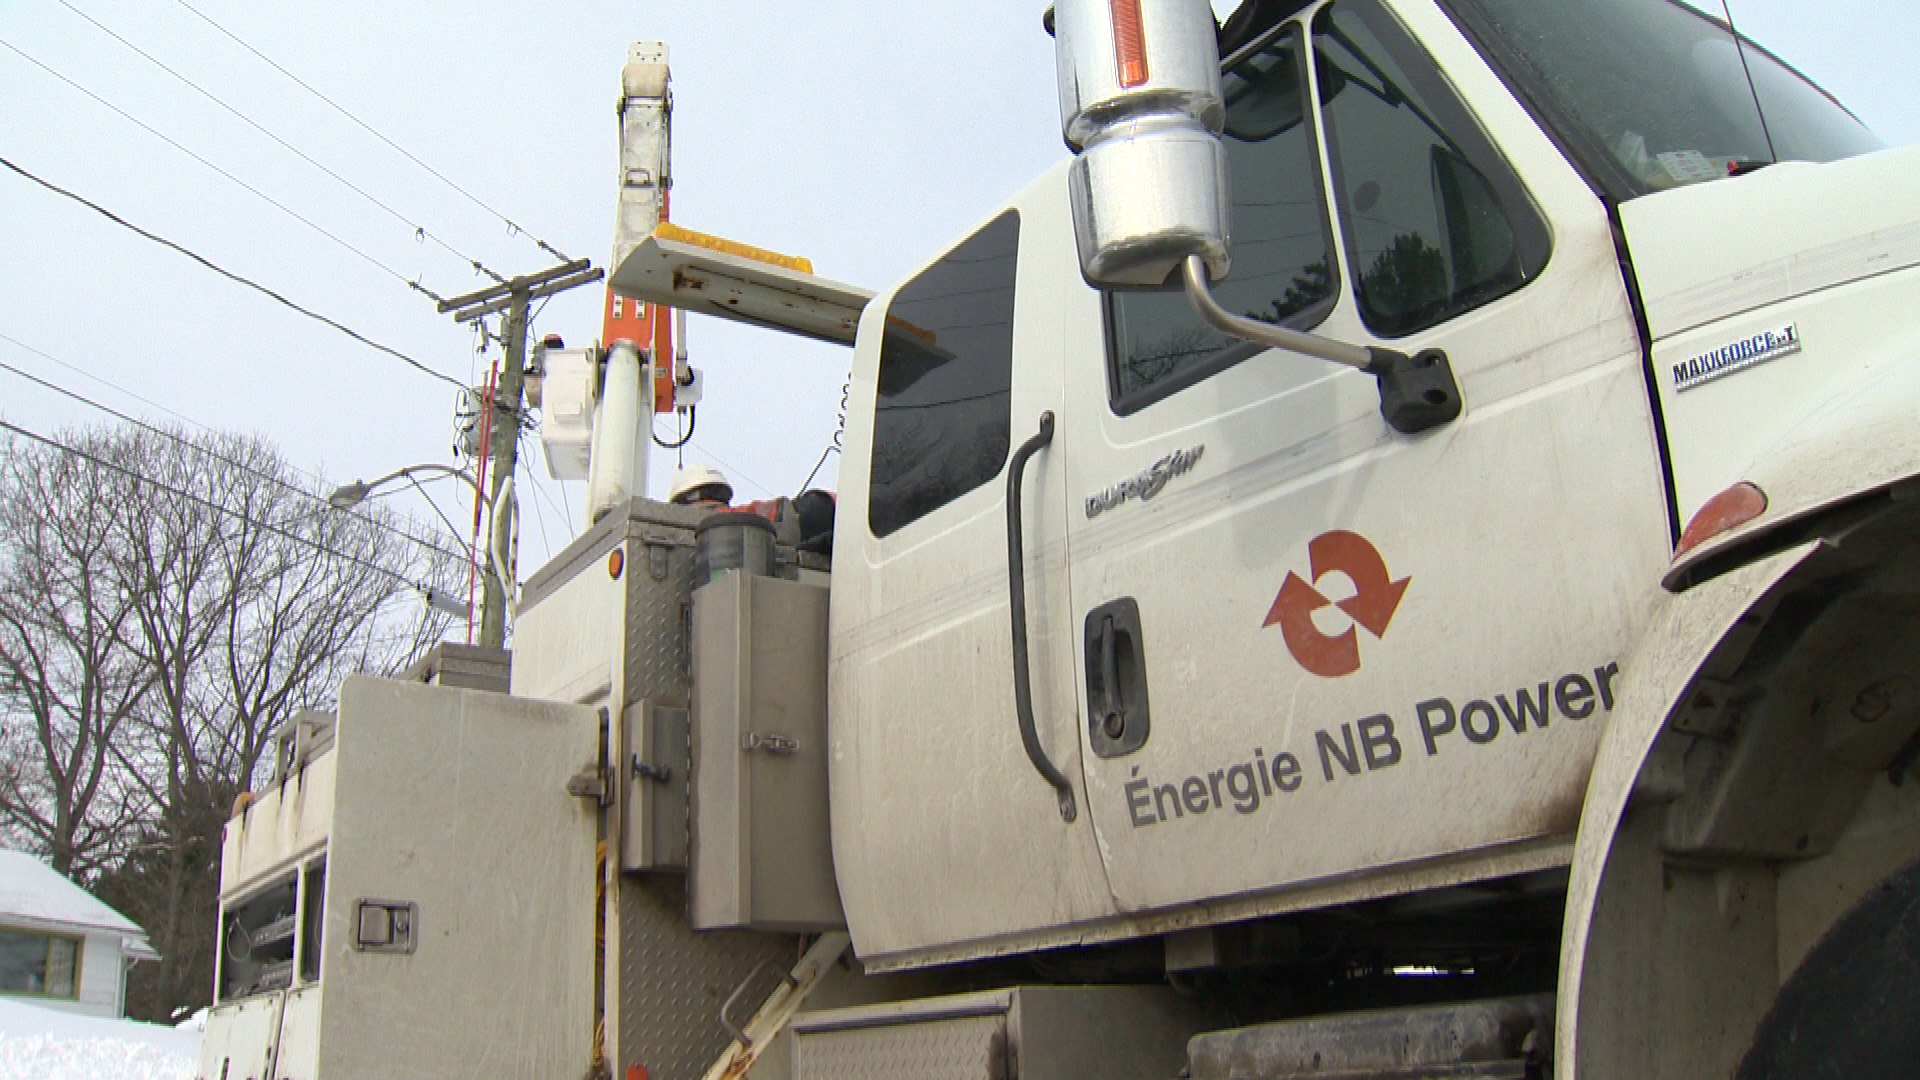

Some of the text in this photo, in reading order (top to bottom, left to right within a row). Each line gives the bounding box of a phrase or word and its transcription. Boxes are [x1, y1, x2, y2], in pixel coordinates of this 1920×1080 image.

[1125, 661, 1619, 828] Énergie NB Power
